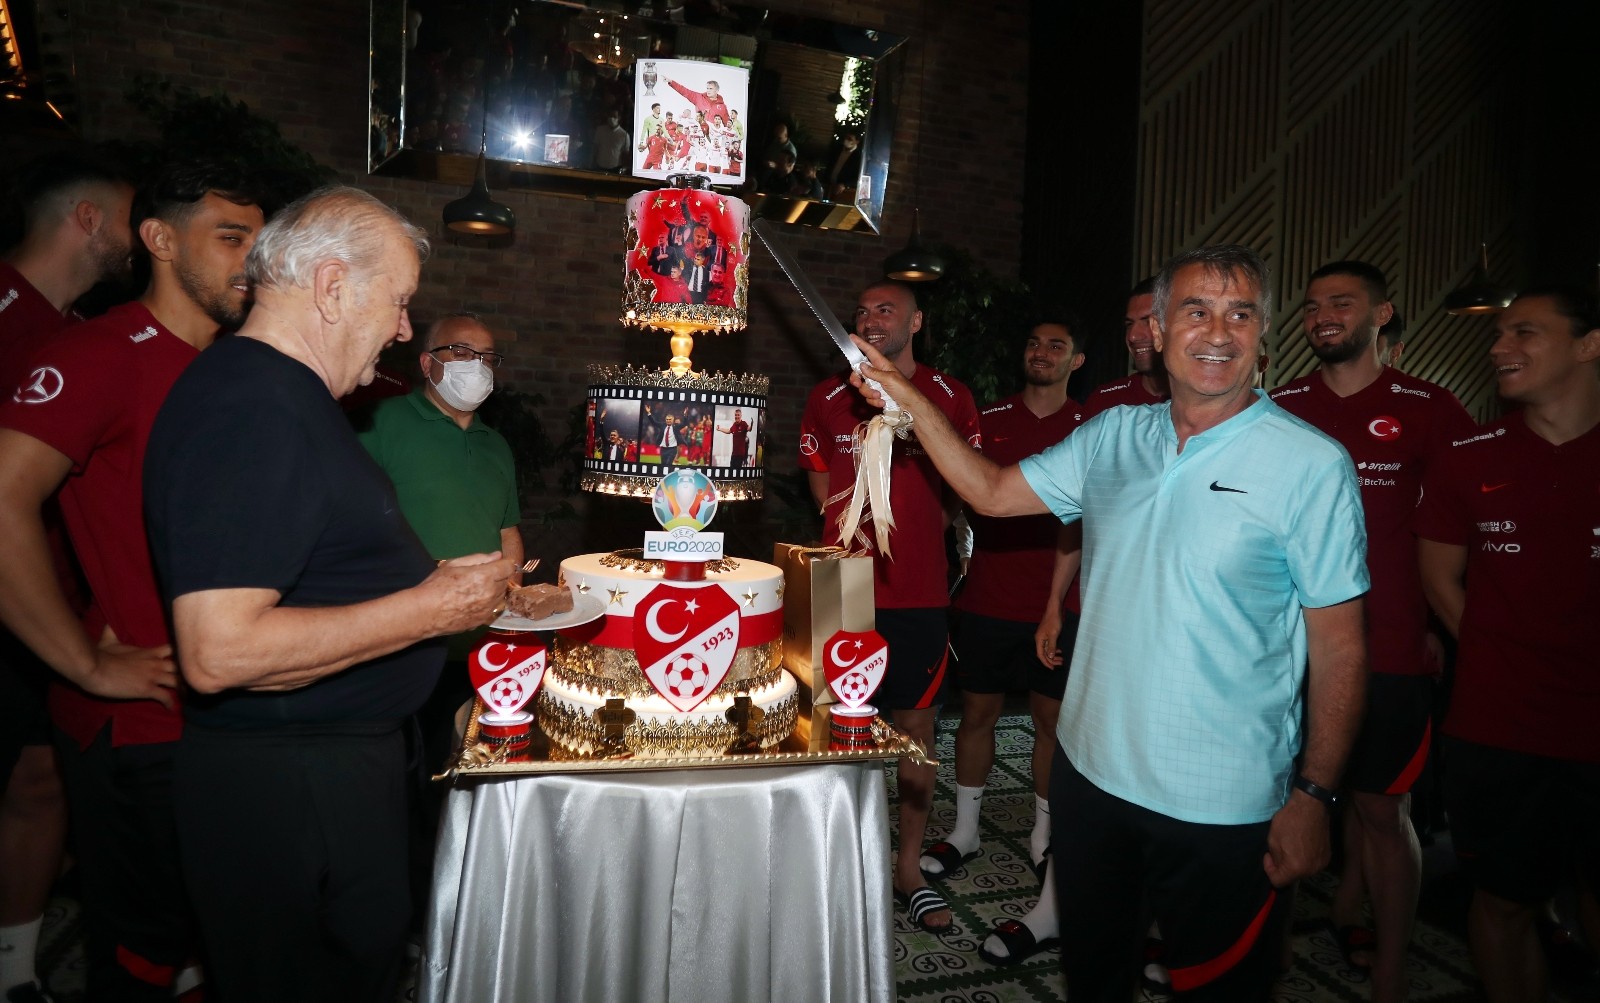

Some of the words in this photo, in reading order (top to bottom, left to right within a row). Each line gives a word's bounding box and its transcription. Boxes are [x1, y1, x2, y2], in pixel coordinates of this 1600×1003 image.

[1401, 388, 1430, 398] TURKCELL
[1452, 432, 1496, 447] DenizBank
[1367, 462, 1402, 472] arçelik
[1364, 478, 1397, 486] BtcTurk
[672, 529, 695, 539] UEFA
[1481, 540, 1521, 553] vivo
[701, 627, 734, 651] 1923
[518, 661, 541, 677] 1923
[864, 657, 883, 672] 1923
